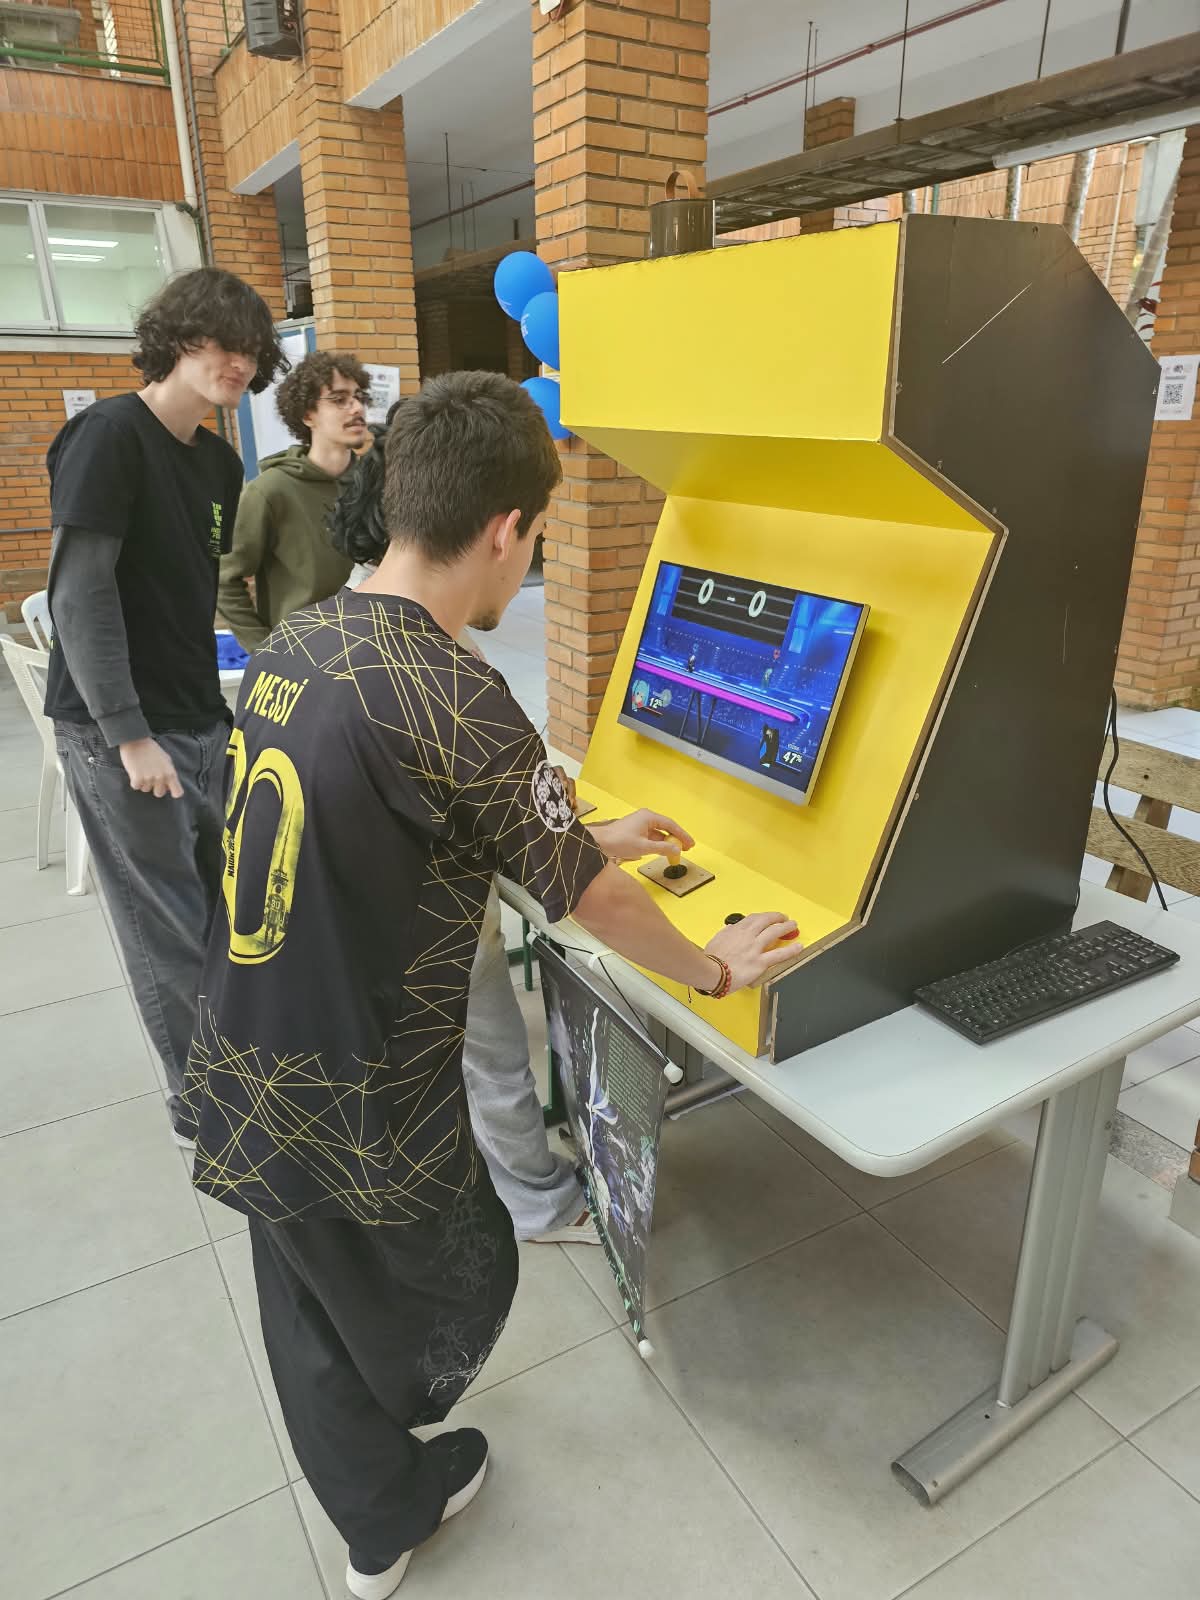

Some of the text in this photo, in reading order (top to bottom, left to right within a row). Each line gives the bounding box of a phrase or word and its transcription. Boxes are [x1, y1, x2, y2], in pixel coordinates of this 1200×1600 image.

[698, 579, 715, 605] 0
[748, 591, 767, 618] 0
[782, 751, 803, 764] 47%
